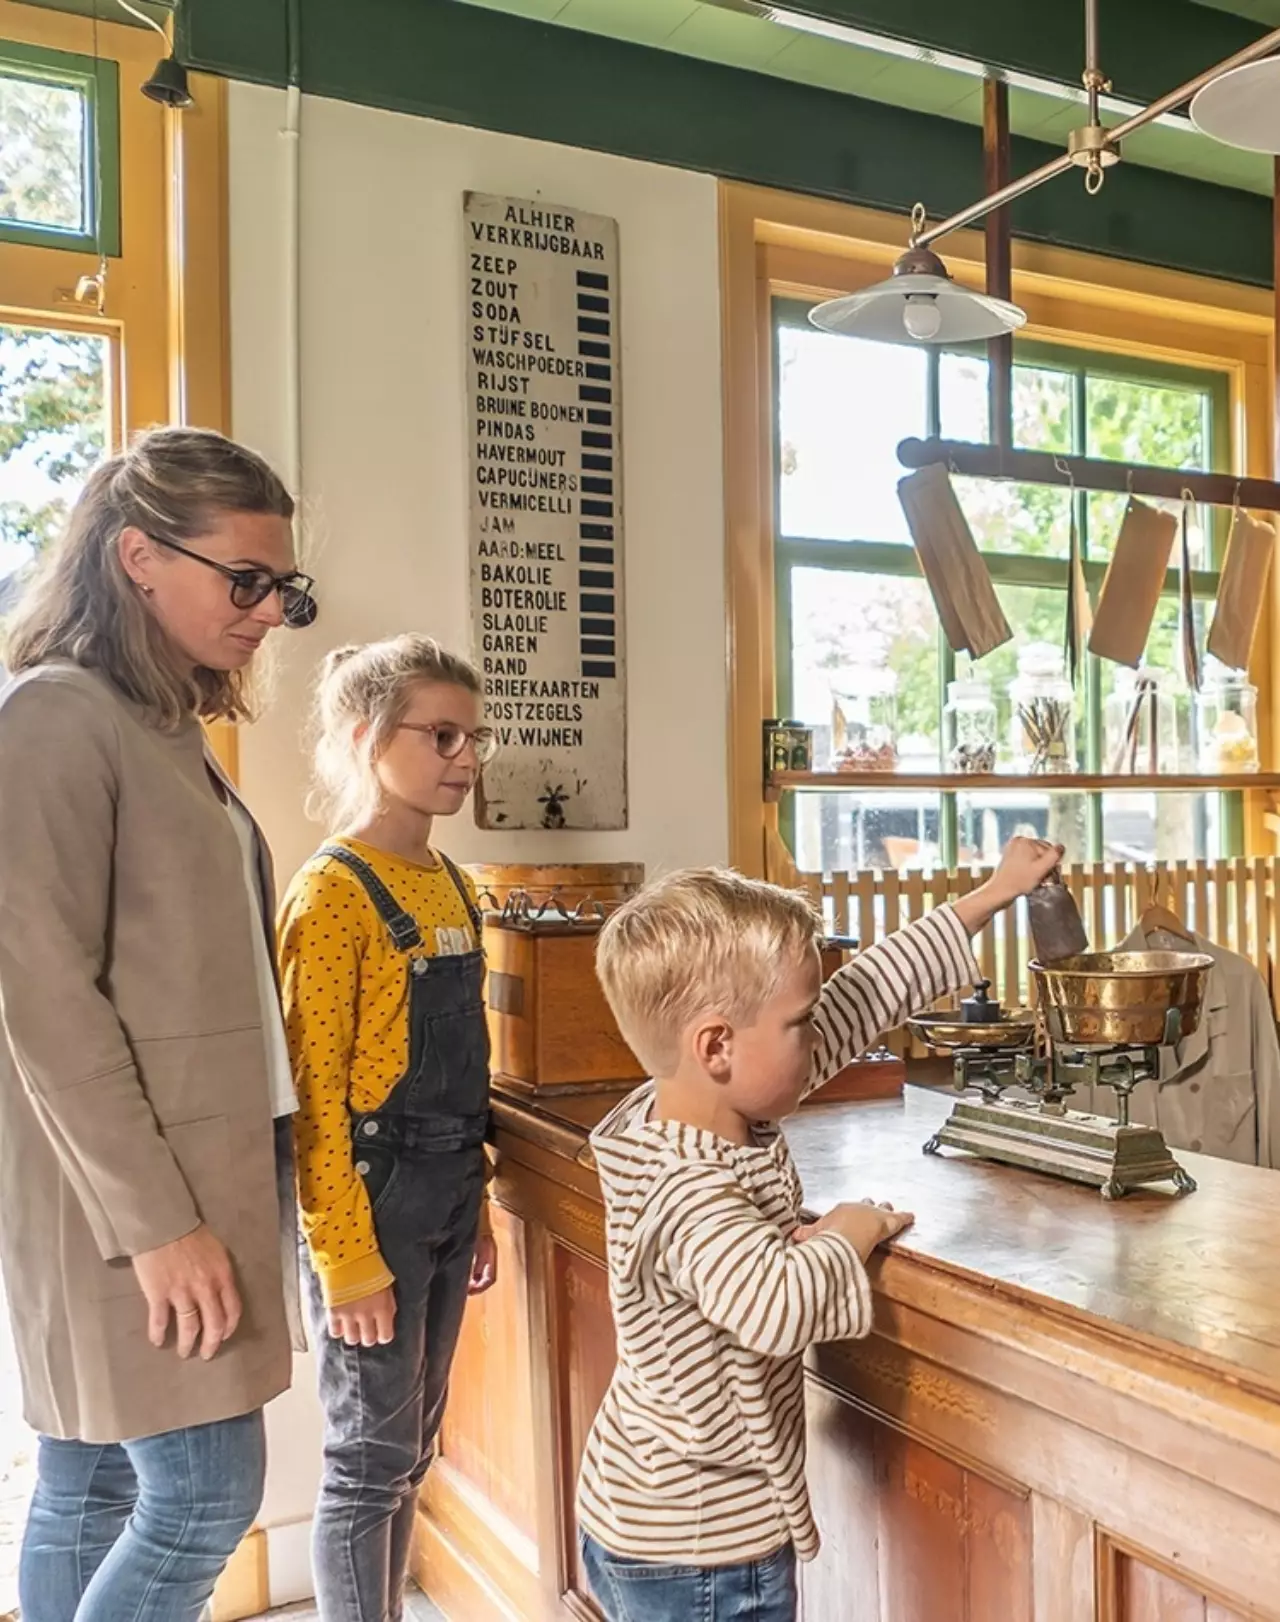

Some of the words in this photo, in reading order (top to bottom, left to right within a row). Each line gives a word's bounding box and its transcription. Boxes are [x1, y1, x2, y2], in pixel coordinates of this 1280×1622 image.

[504, 206, 576, 233] ALHIER
[470, 222, 605, 260] VERKRIJGBAAR
[470, 254, 517, 276] ZEEP
[471, 278, 518, 300] ZOUT
[472, 302, 521, 324] SODA
[473, 348, 585, 378] WASCHPOEDER
[478, 372, 530, 394] RIJST
[476, 396, 526, 418] BRUINE
[530, 401, 585, 423] BOONEN
[477, 419, 535, 441] PINDAS
[477, 443, 565, 467] HAVERMOUT
[478, 491, 572, 515] VERMICELLI
[480, 516, 515, 534] JAM
[481, 564, 552, 586] BAKOLIE
[481, 588, 567, 611] BOTEROLIE
[483, 614, 548, 633] SLAOLIE
[483, 635, 538, 653] GAREN
[484, 657, 527, 676] BAND
[485, 679, 599, 699] BRIEFKAARTEN
[484, 702, 582, 721] POSTZEGELS
